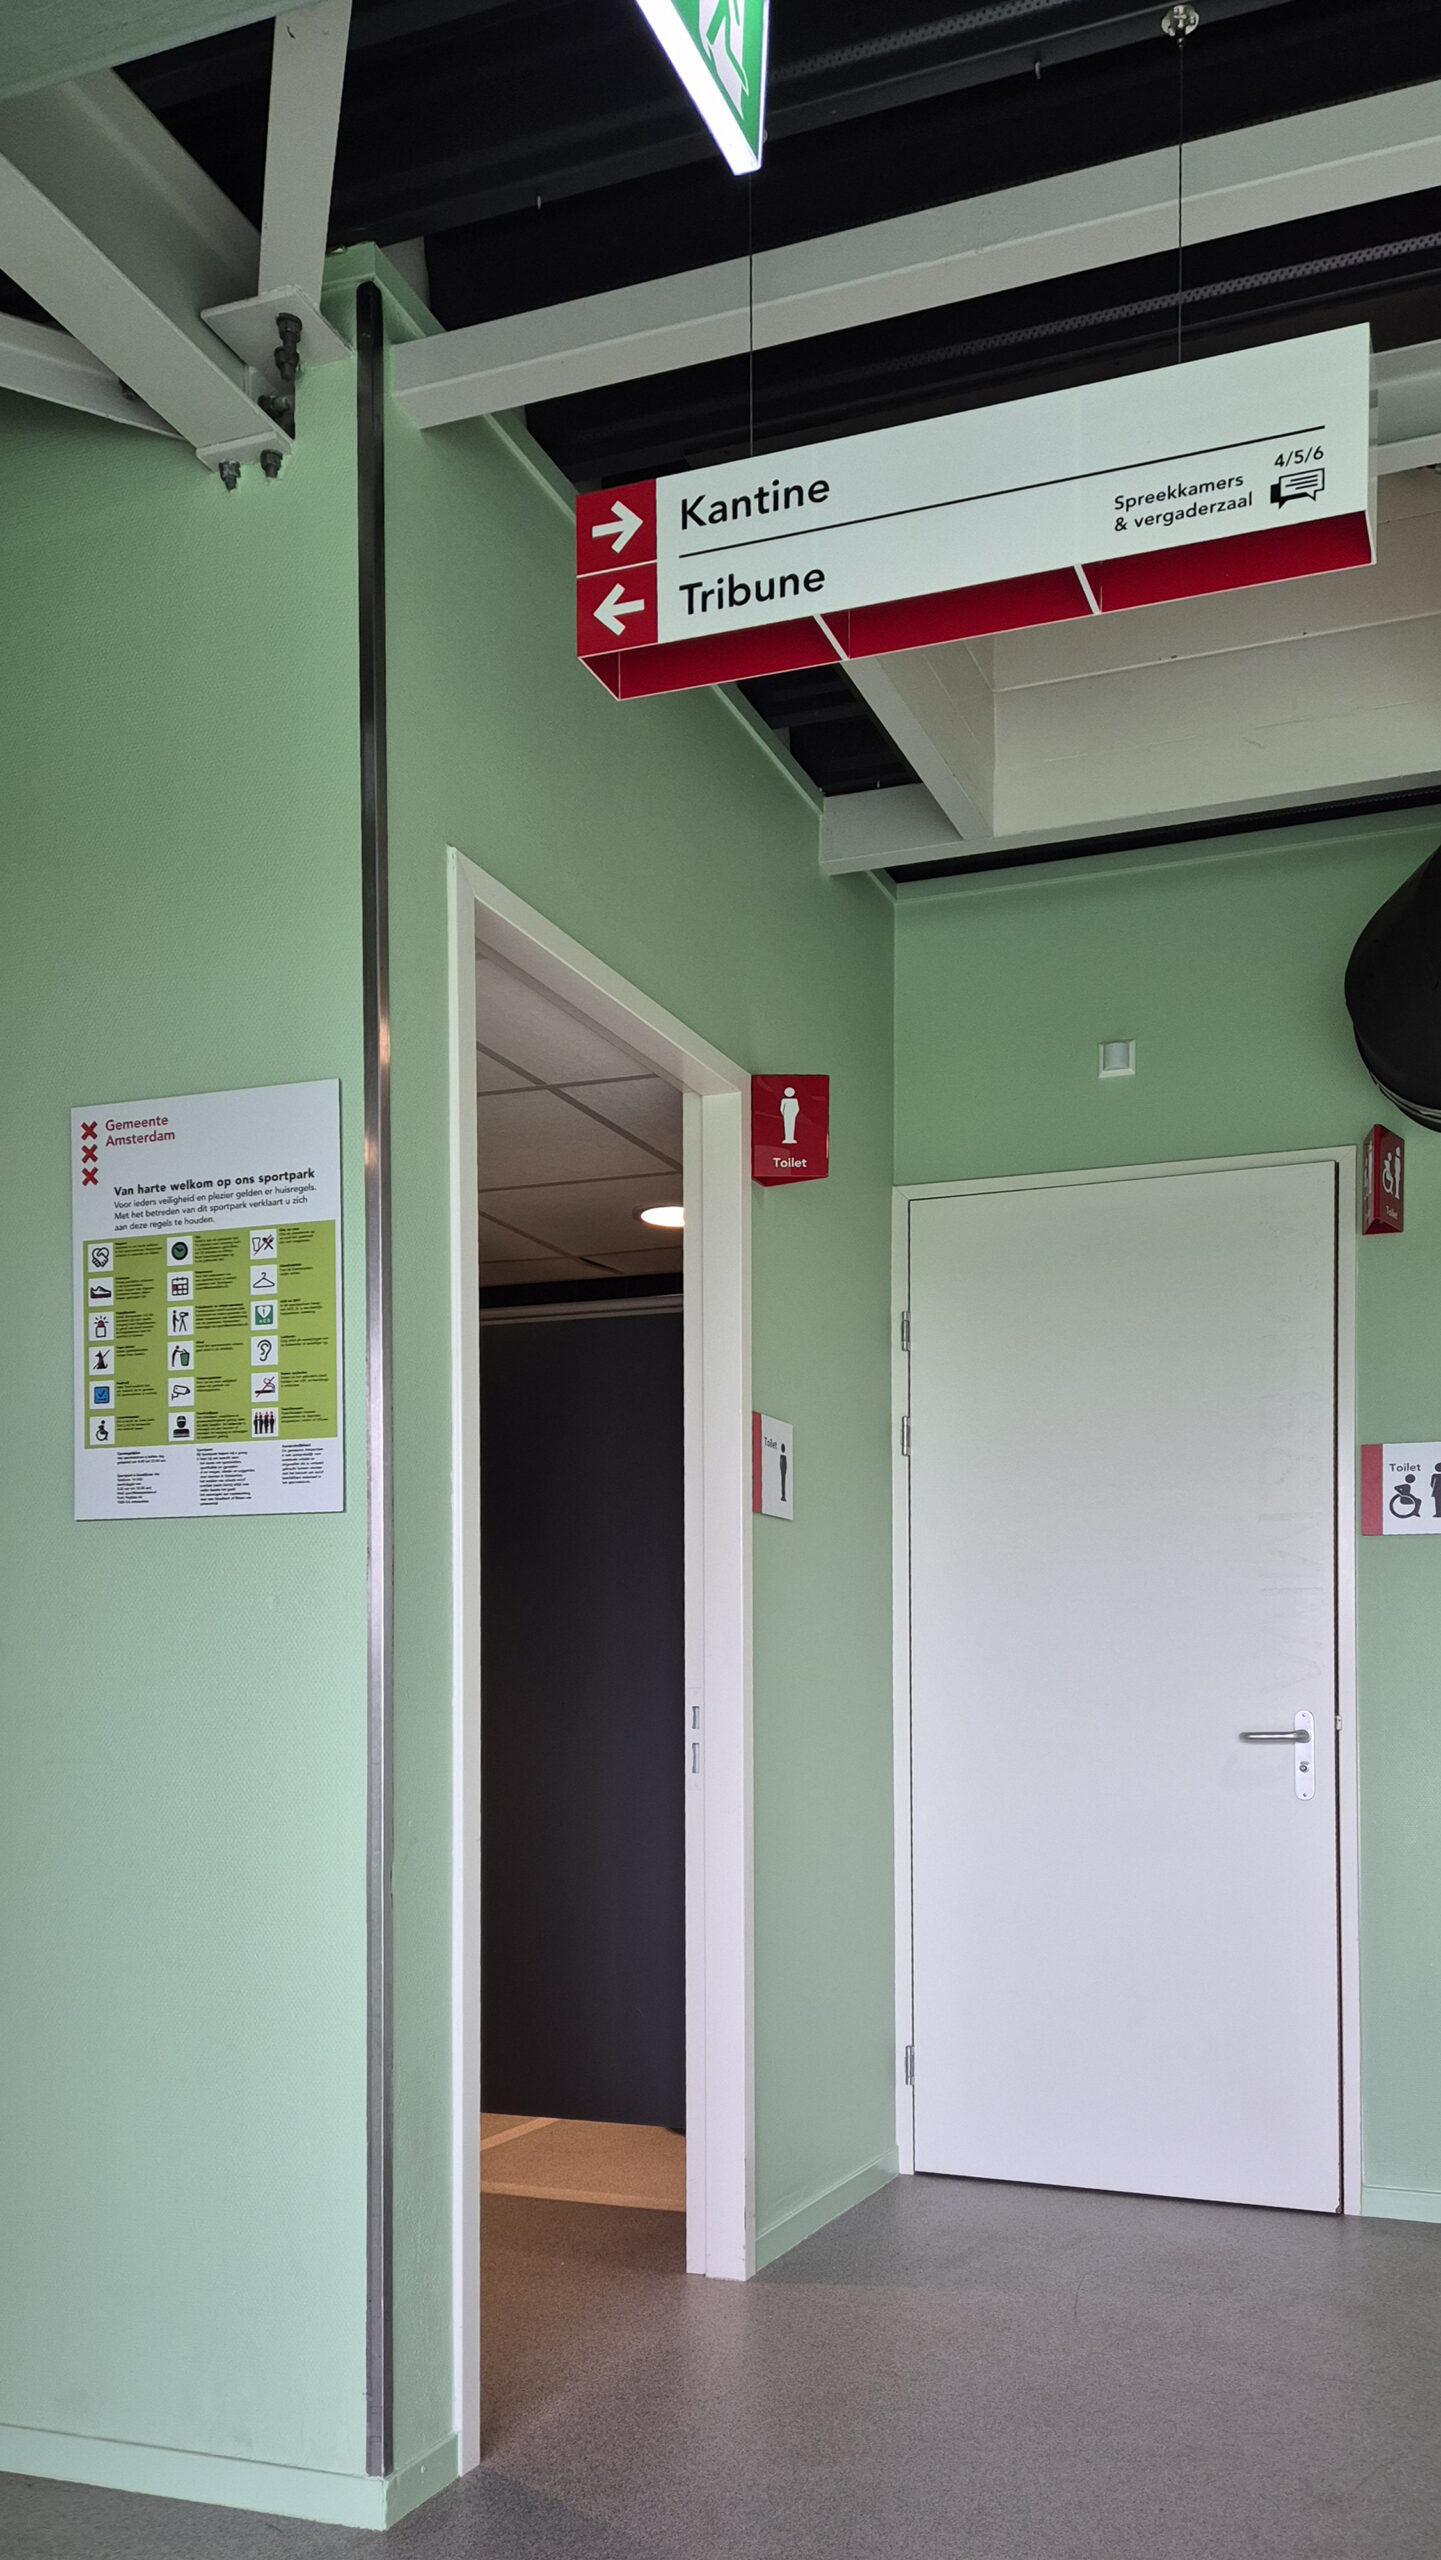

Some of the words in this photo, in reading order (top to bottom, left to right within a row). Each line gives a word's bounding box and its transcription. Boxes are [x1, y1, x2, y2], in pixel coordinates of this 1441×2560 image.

[1273, 445, 1324, 468] 4/5/6
[681, 479, 830, 530] Kantine
[1114, 474, 1245, 512] Spreekkamers
[1114, 517, 1128, 532] &
[1134, 491, 1253, 527] vergaderzaal
[679, 568, 825, 615] Tribune
[105, 1115, 169, 1132] Gemeente
[105, 1130, 176, 1147] Amsterdam
[772, 1157, 808, 1168] Toilet
[113, 1186, 134, 1196] Van
[137, 1184, 167, 1195] harte
[170, 1179, 214, 1191] welkom
[216, 1178, 231, 1189] op
[235, 1176, 255, 1186] ons
[258, 1167, 316, 1185] sportpark
[113, 1201, 132, 1209] Voor
[133, 1198, 157, 1207] ieders
[158, 1194, 195, 1206] veiligheid
[196, 1194, 206, 1202] en
[207, 1191, 234, 1203] plezier
[235, 1188, 263, 1200] gelden
[264, 1187, 273, 1195] er
[275, 1183, 317, 1195] huisregels.
[114, 1211, 130, 1220] Met
[131, 1210, 144, 1219] het
[145, 1207, 180, 1218] betreden
[181, 1206, 196, 1214] van
[197, 1204, 208, 1213] dit
[209, 1200, 247, 1214] sportpark
[248, 1198, 284, 1209] verklaart
[292, 1194, 308, 1205] zich
[114, 1223, 128, 1232] aan
[129, 1221, 148, 1230] deze
[149, 1218, 173, 1230] regels
[174, 1218, 183, 1226] te
[184, 1216, 216, 1226] houden.
[763, 1435, 778, 1451] Toilet
[1388, 1462, 1422, 1472] Toilet
